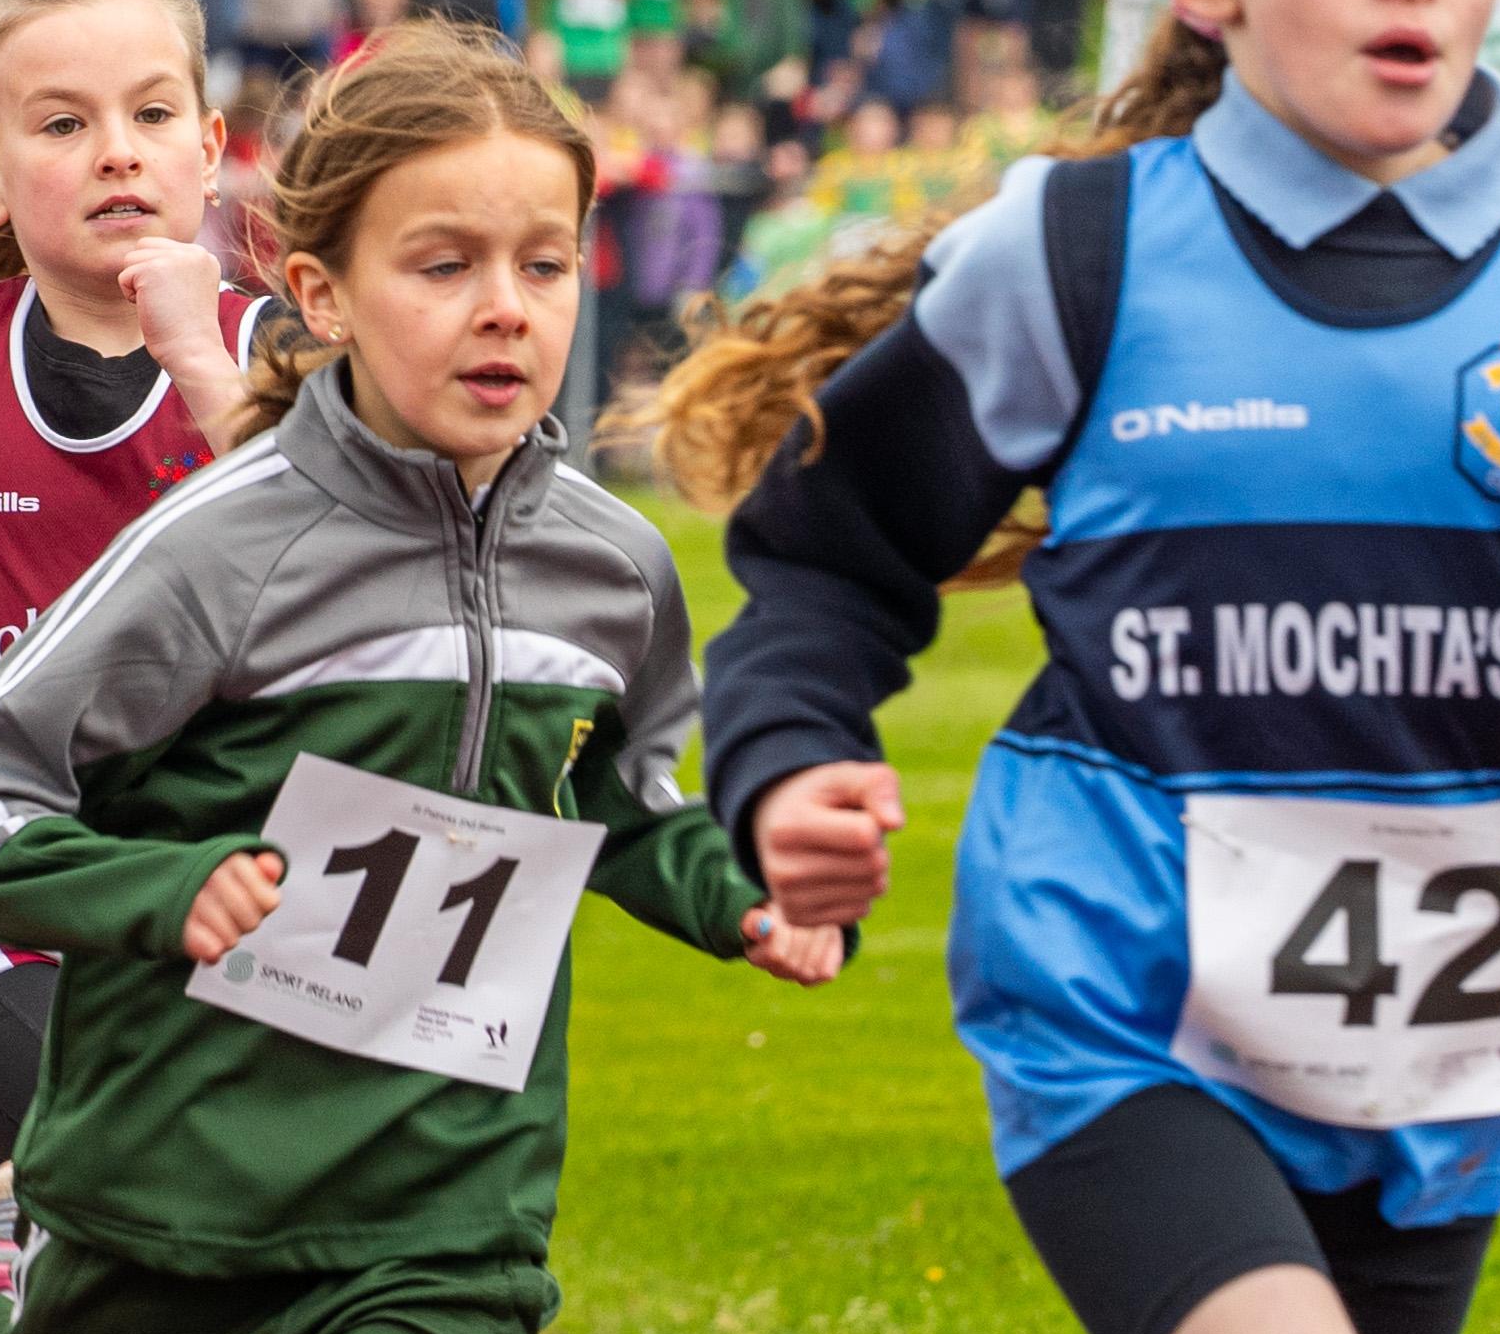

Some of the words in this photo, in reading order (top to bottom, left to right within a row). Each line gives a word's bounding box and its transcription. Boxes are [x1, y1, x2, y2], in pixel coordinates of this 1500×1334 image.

[1111, 606, 1199, 701] ST.
[323, 827, 520, 988] 11
[260, 963, 304, 990] SPORT
[305, 981, 364, 1013] IRELAND
